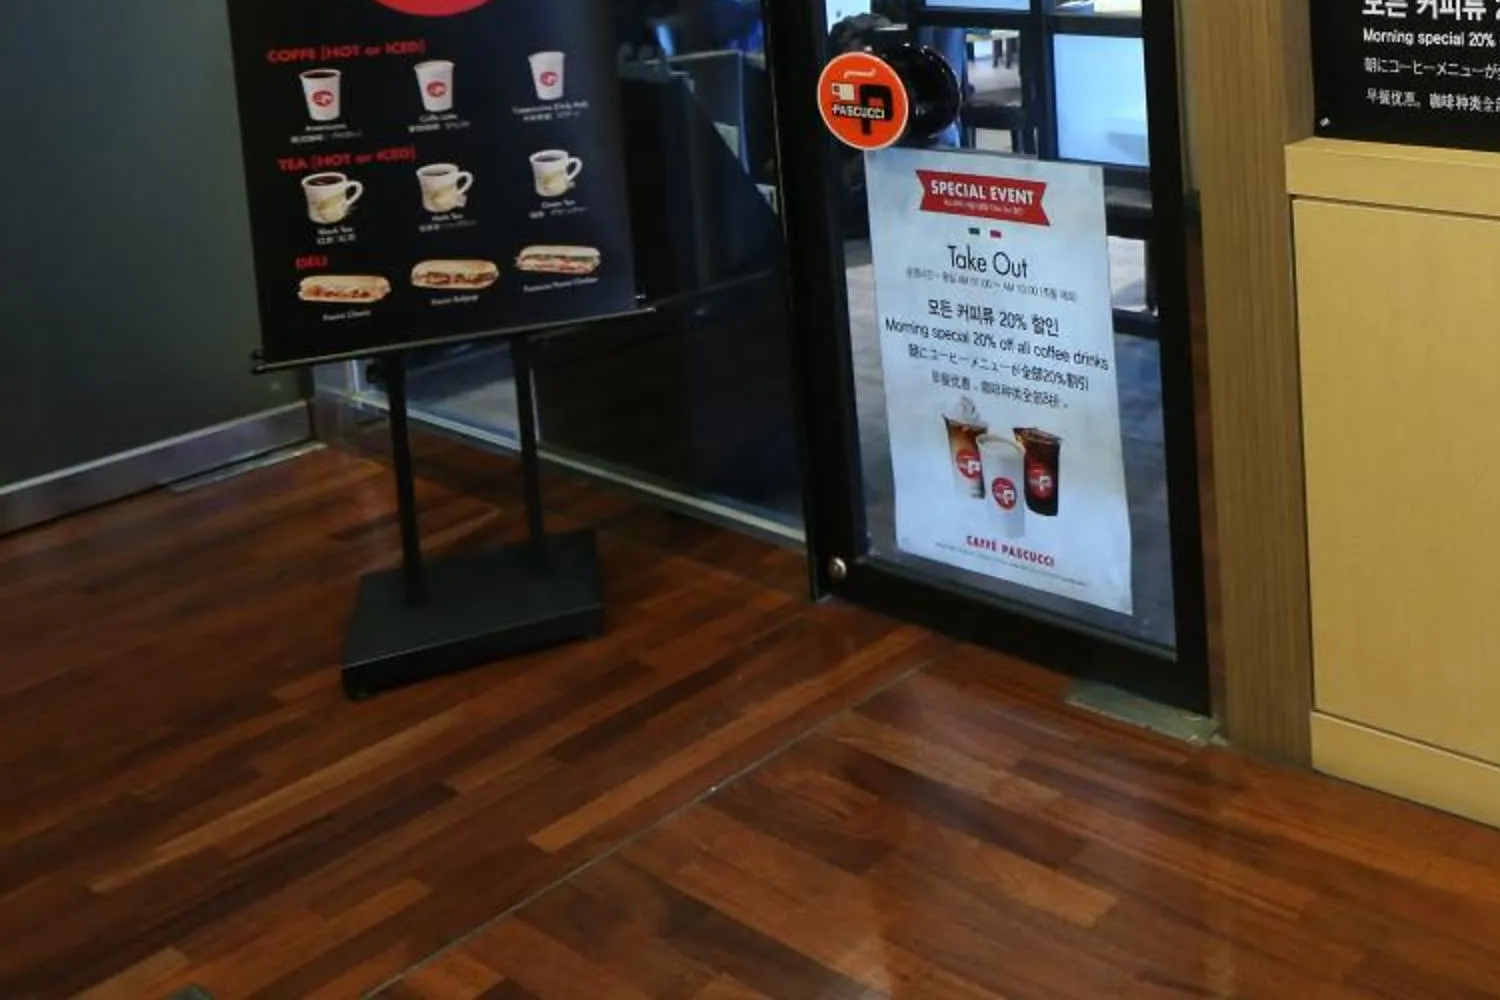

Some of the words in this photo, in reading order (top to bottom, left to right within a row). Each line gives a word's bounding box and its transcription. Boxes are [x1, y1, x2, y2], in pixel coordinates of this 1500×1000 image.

[1363, 27, 1414, 47] Morning
[1418, 30, 1465, 49] special
[1469, 31, 1496, 48] 20%
[931, 179, 987, 200] SPECIAL
[989, 185, 1036, 205] EVENT
[947, 244, 987, 273] Take
[993, 251, 1028, 279] Out
[928, 299, 953, 319] 모든
[957, 303, 995, 328] 커피류
[999, 310, 1028, 332] 20%
[1031, 313, 1059, 338] 할인
[885, 317, 929, 339] Morning
[931, 326, 969, 344] special
[973, 330, 998, 350] 20%
[1017, 342, 1032, 356] all
[1033, 344, 1071, 362] coffee
[1073, 349, 1109, 372] drinks
[1001, 544, 1055, 568] PASCUCCI
